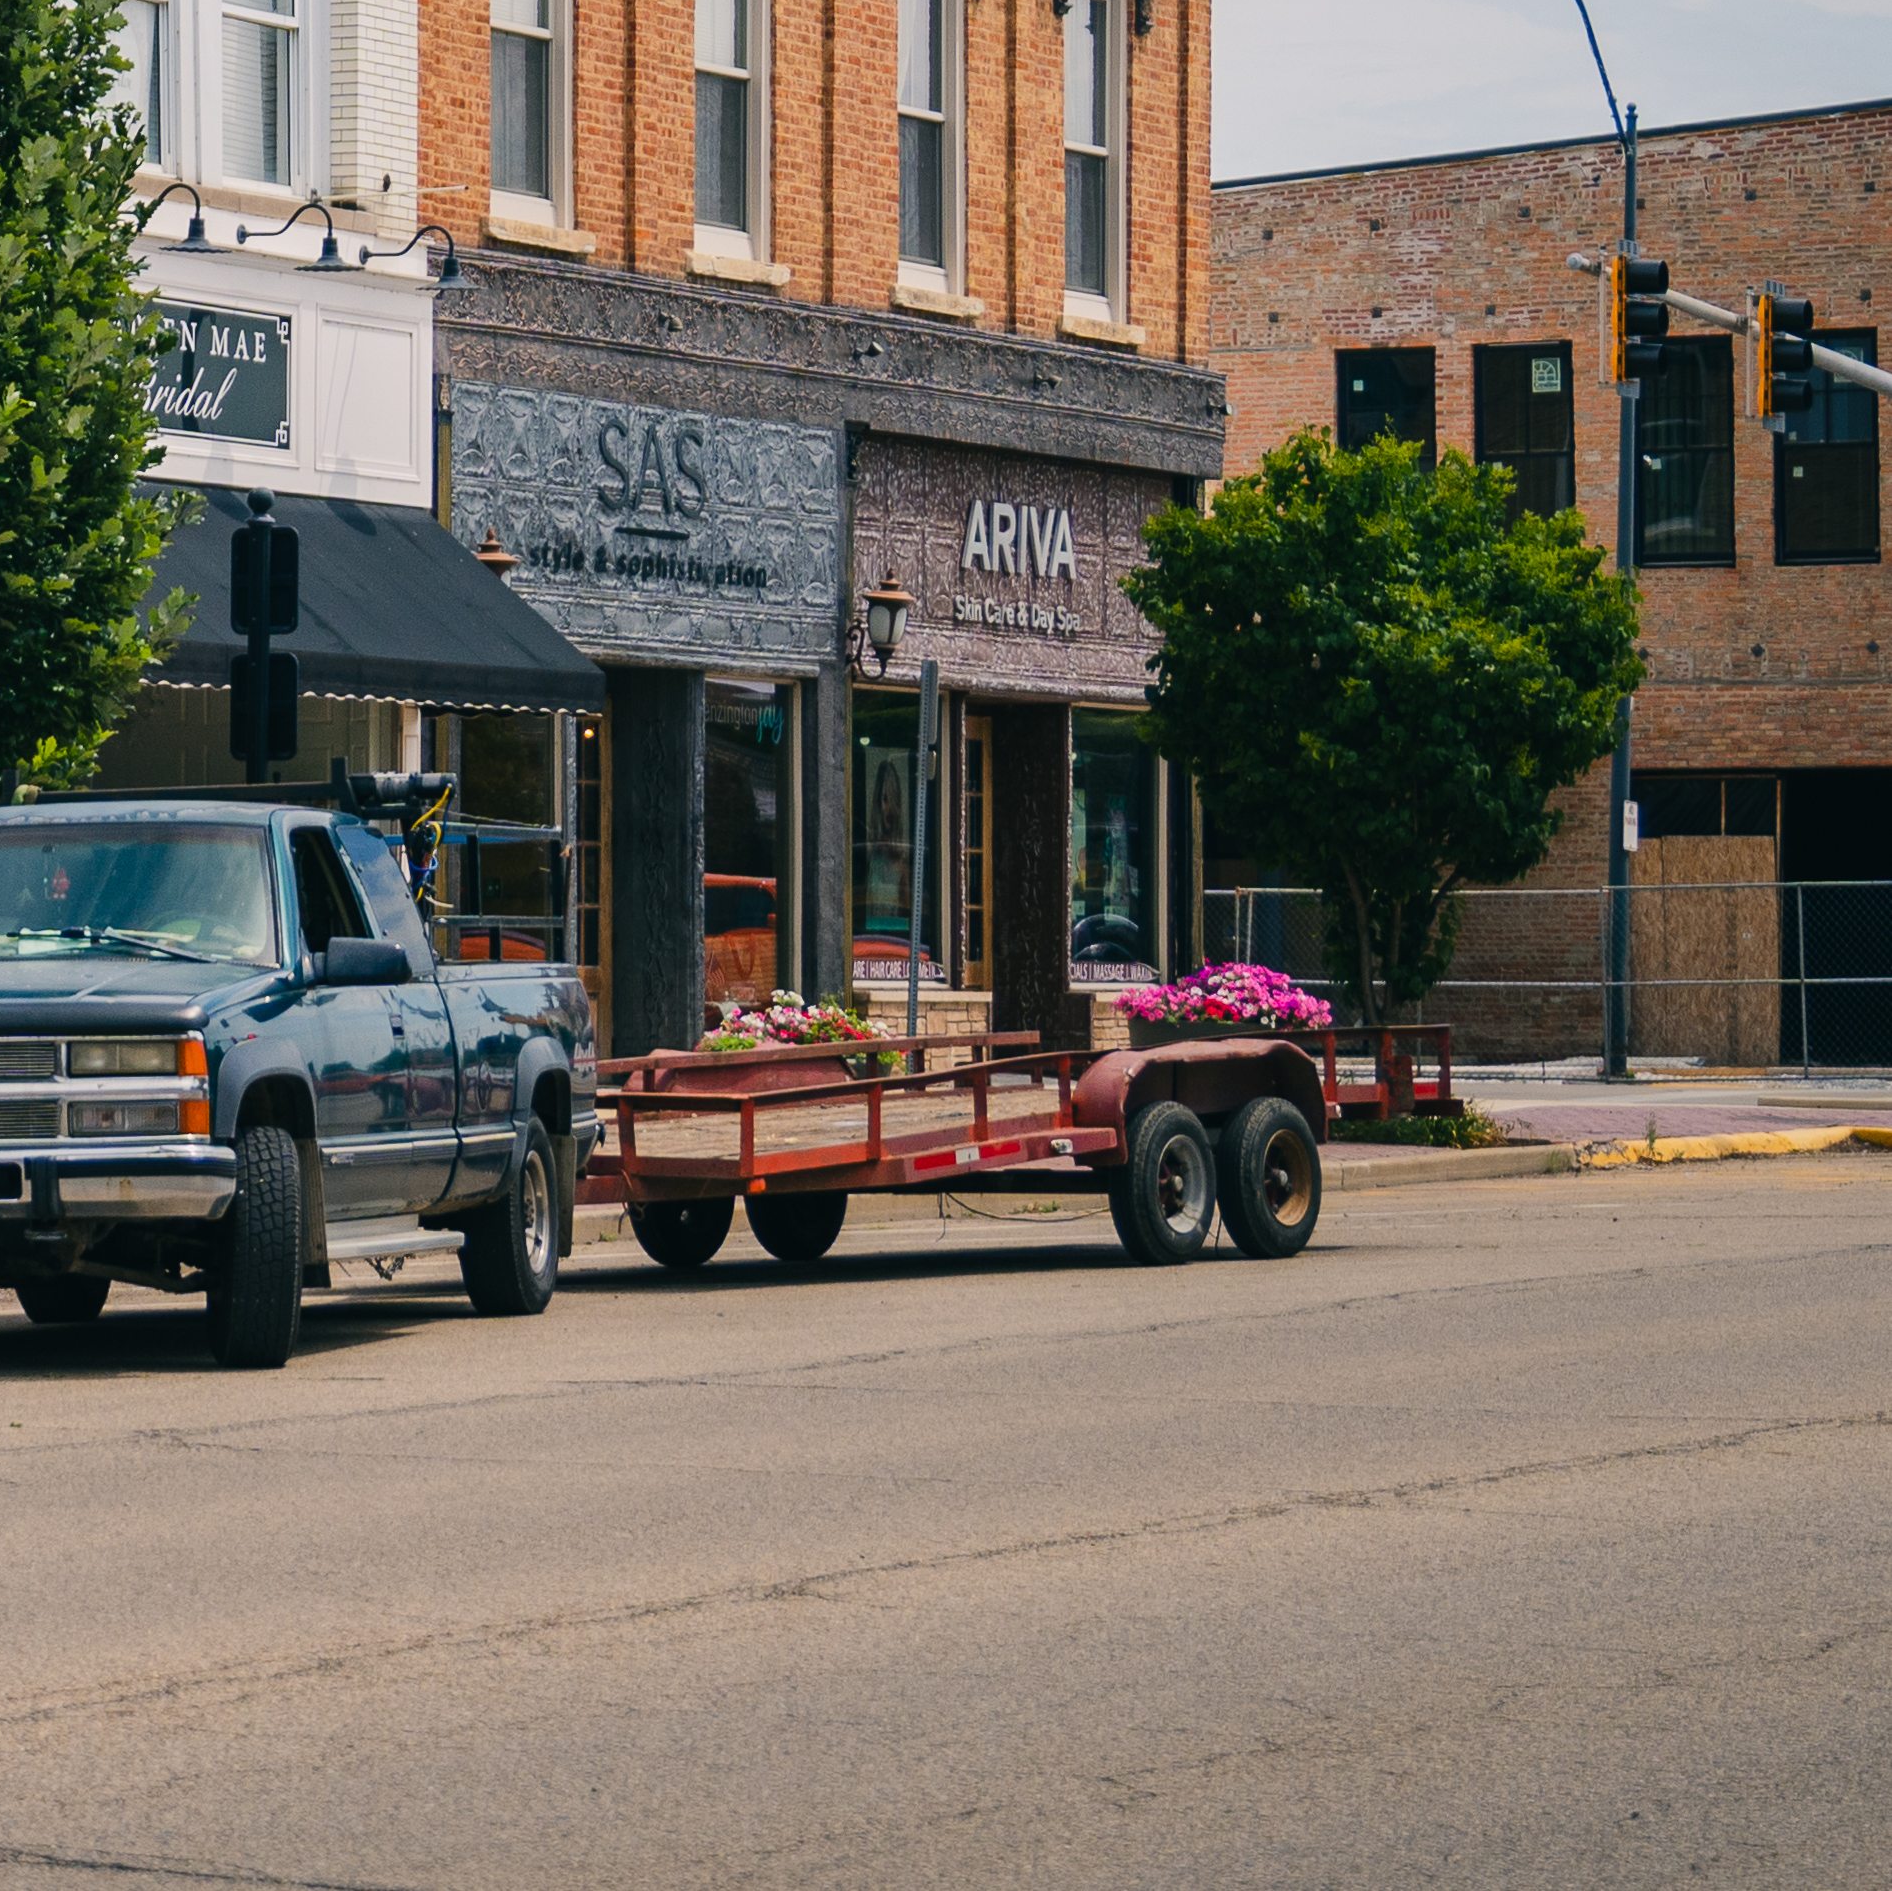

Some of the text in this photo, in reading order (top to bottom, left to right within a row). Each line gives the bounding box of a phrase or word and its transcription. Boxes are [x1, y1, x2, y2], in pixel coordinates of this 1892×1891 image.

[210, 325, 267, 363] MAE
[598, 418, 706, 519] SAS
[961, 499, 1077, 579] ARIVA
[529, 541, 767, 588] style & sophistiation
[955, 595, 1081, 636] Skin Care & Day Spa
[1094, 964, 1124, 980] MASSAGE
